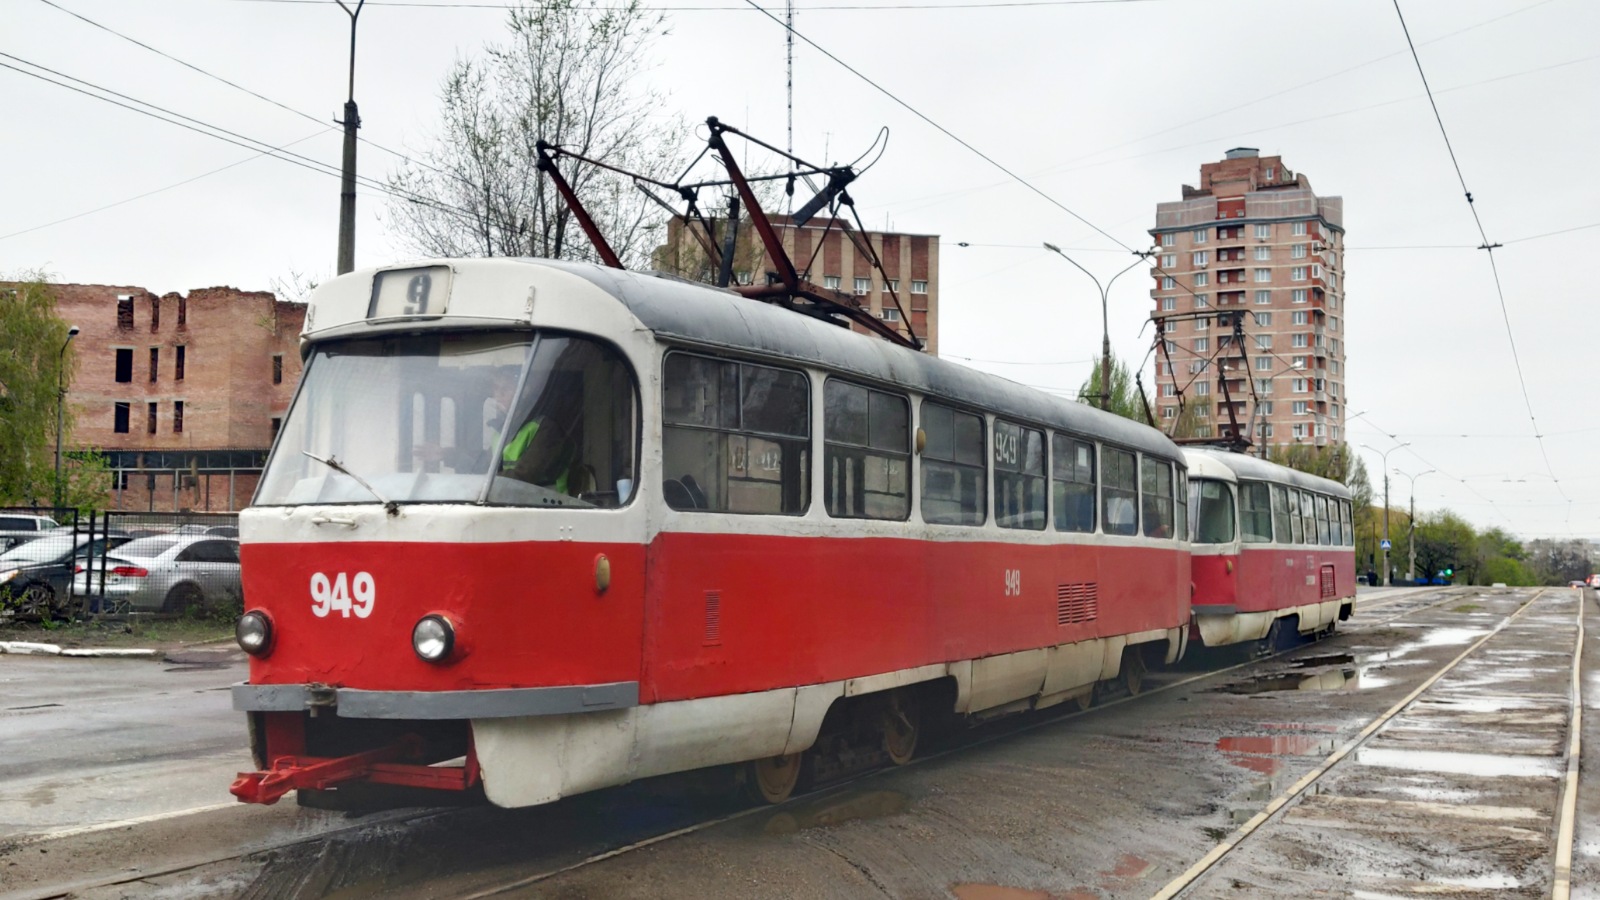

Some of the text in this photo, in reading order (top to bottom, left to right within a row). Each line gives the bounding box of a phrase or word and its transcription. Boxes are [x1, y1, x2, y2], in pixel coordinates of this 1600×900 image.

[404, 273, 432, 316] 9
[995, 432, 1017, 464] 949
[310, 572, 376, 618] 949
[1005, 569, 1020, 596] 949
